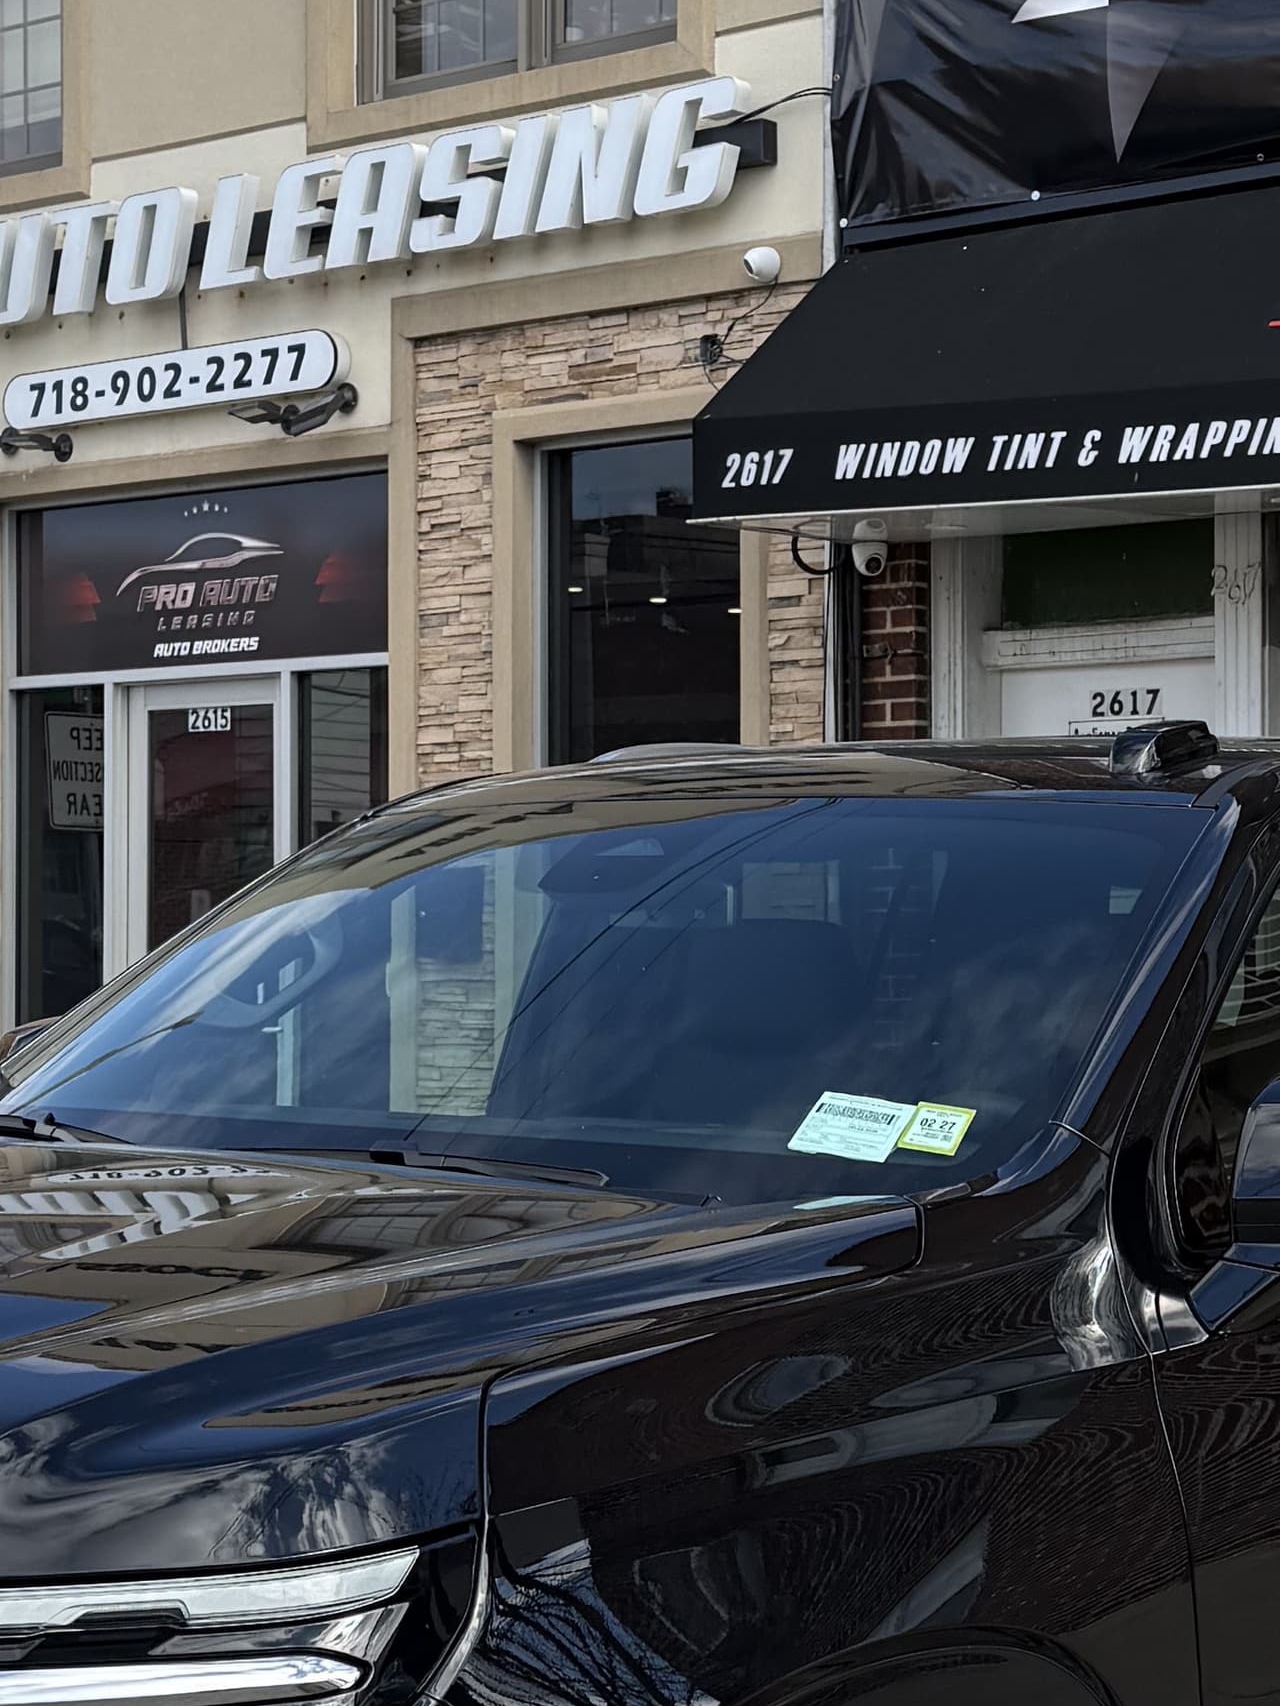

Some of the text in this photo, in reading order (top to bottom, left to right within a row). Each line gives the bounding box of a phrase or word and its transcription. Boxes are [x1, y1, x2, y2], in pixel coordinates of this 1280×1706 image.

[198, 75, 751, 290] LEASING
[29, 343, 306, 418] 718-902-2277
[722, 448, 794, 489] 2617
[834, 437, 974, 480] WINDOW
[987, 430, 1066, 473] TINT
[1077, 428, 1102, 466] &
[137, 575, 279, 612] PRO AUTO
[157, 610, 256, 631] LEASING
[153, 636, 260, 658] AUTO BROKERS
[1091, 688, 1161, 717] 2617
[191, 708, 229, 731] 2615
[939, 1120, 957, 1131] 27
